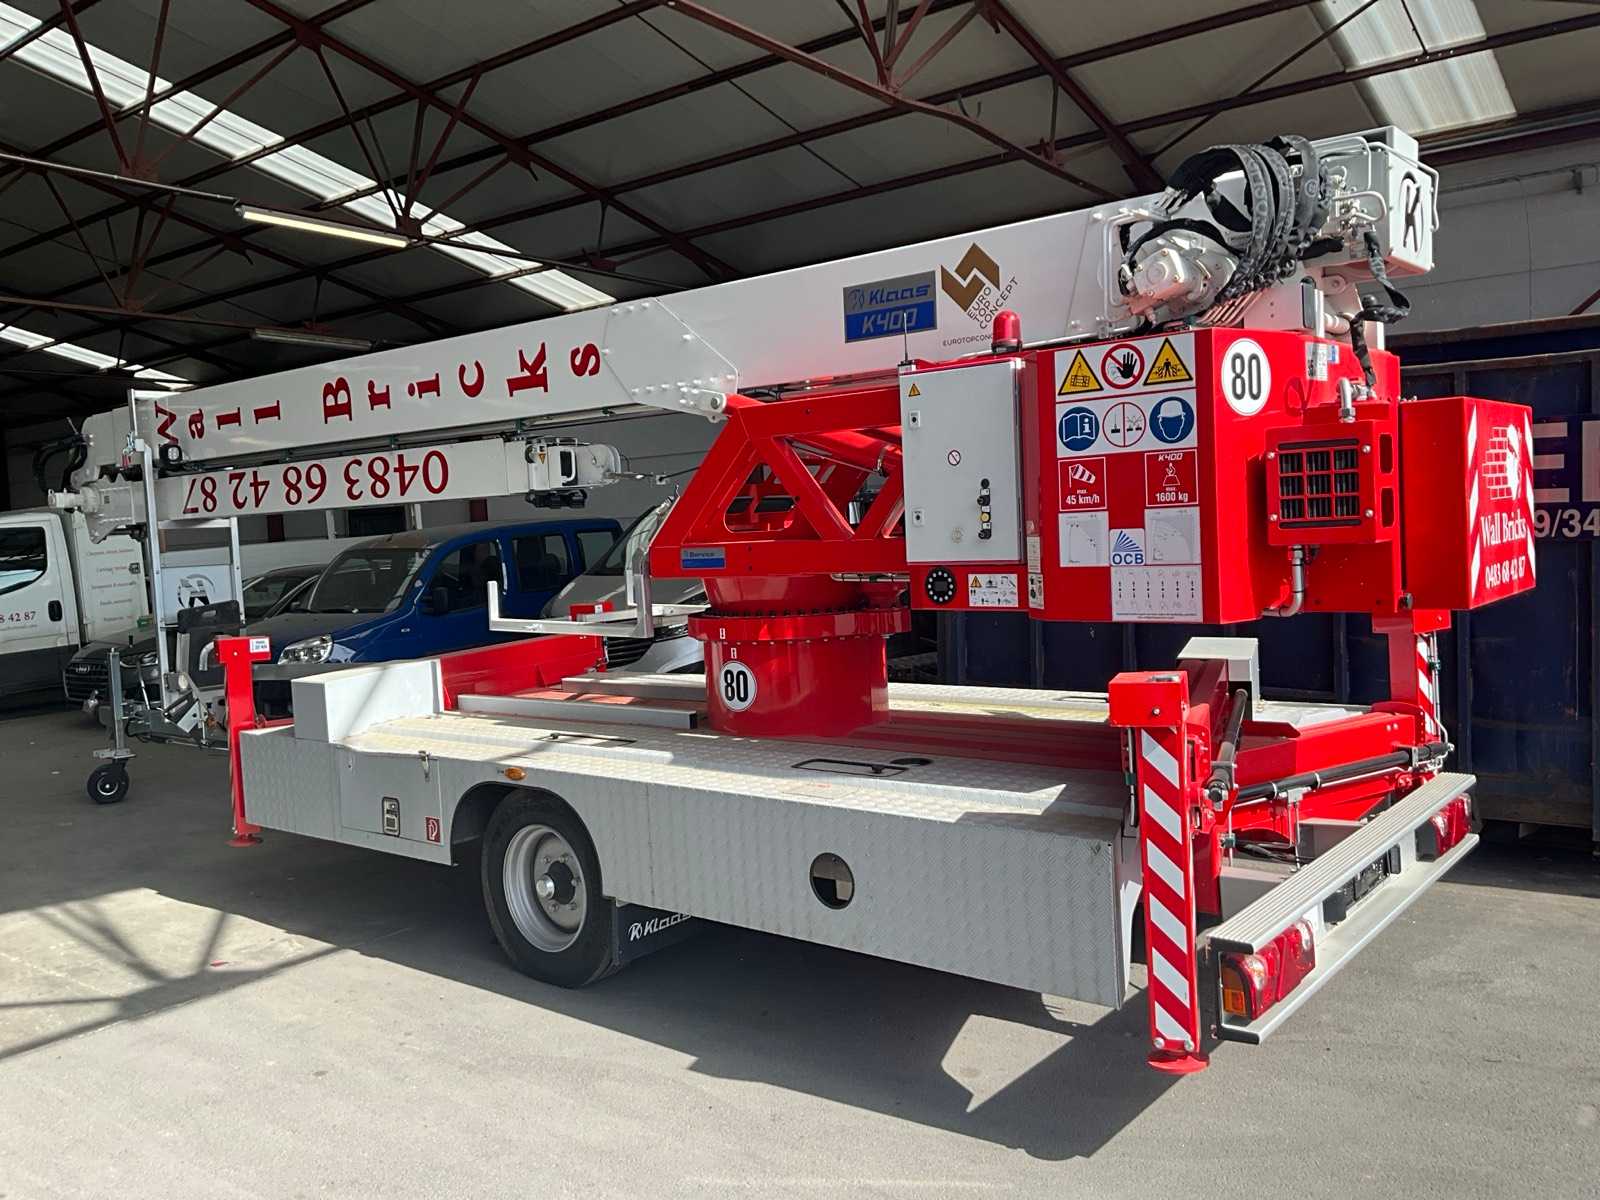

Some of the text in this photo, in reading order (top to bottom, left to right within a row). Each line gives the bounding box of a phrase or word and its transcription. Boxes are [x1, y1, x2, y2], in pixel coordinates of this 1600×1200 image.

[869, 284, 931, 305] Klaas
[967, 286, 992, 319] EURO
[979, 276, 1019, 330] CONCEPT
[862, 307, 918, 334] K400
[972, 300, 992, 323] TOP
[943, 334, 993, 347] EUROTOPCON
[322, 341, 602, 424] Bricks
[1231, 352, 1262, 401] 80
[182, 449, 449, 515] 0483 68 42 87
[1065, 494, 1100, 505] 45 km/h
[1155, 491, 1189, 503] 1600 kg
[1480, 508, 1527, 549] Wall Bricks
[1112, 553, 1144, 565] OCB
[8, 612, 21, 622] 42
[24, 611, 36, 621] 87
[723, 669, 749, 702] 80
